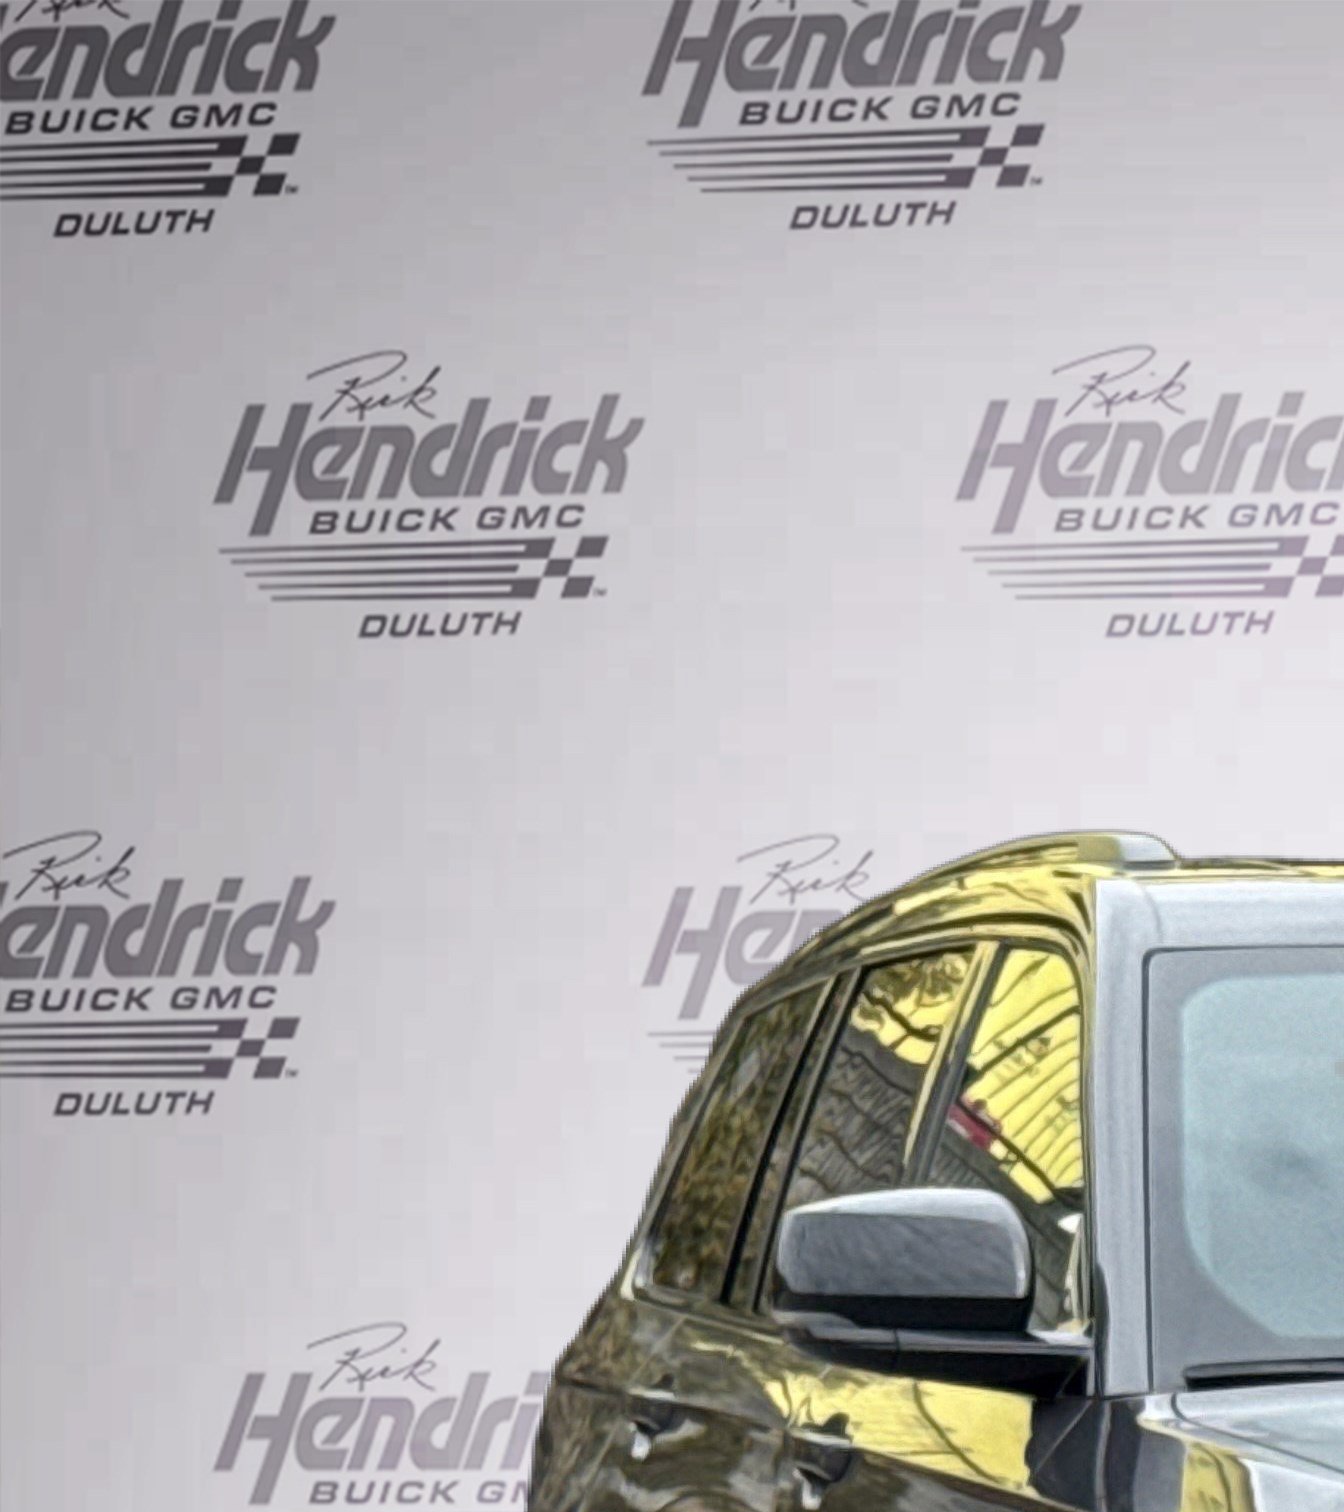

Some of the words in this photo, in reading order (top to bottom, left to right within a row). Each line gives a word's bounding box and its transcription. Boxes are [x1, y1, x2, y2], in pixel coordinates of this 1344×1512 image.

[0, 0, 337, 104] endrick
[640, 0, 1084, 130] Hendrick
[3, 104, 155, 137] BUICK
[168, 101, 278, 130] GMC
[738, 95, 894, 127] BUICK
[908, 91, 1022, 120] GMC
[52, 208, 216, 239] DULUTH
[788, 200, 958, 231] DULUTH
[212, 392, 646, 538] Hendrick
[308, 506, 461, 536] BUICK
[476, 503, 586, 531] GMC
[1053, 503, 1211, 533] BUICK
[1227, 500, 1341, 529] GMC
[357, 610, 523, 639] DULUTH
[1105, 609, 1276, 639] DULUTH
[0, 875, 337, 981] endrick
[3, 986, 155, 1014] BUICK
[169, 984, 278, 1012] GMC
[52, 1089, 216, 1117] DULUTH
[212, 1371, 552, 1506] Hendri
[308, 1479, 460, 1505] BUICK
